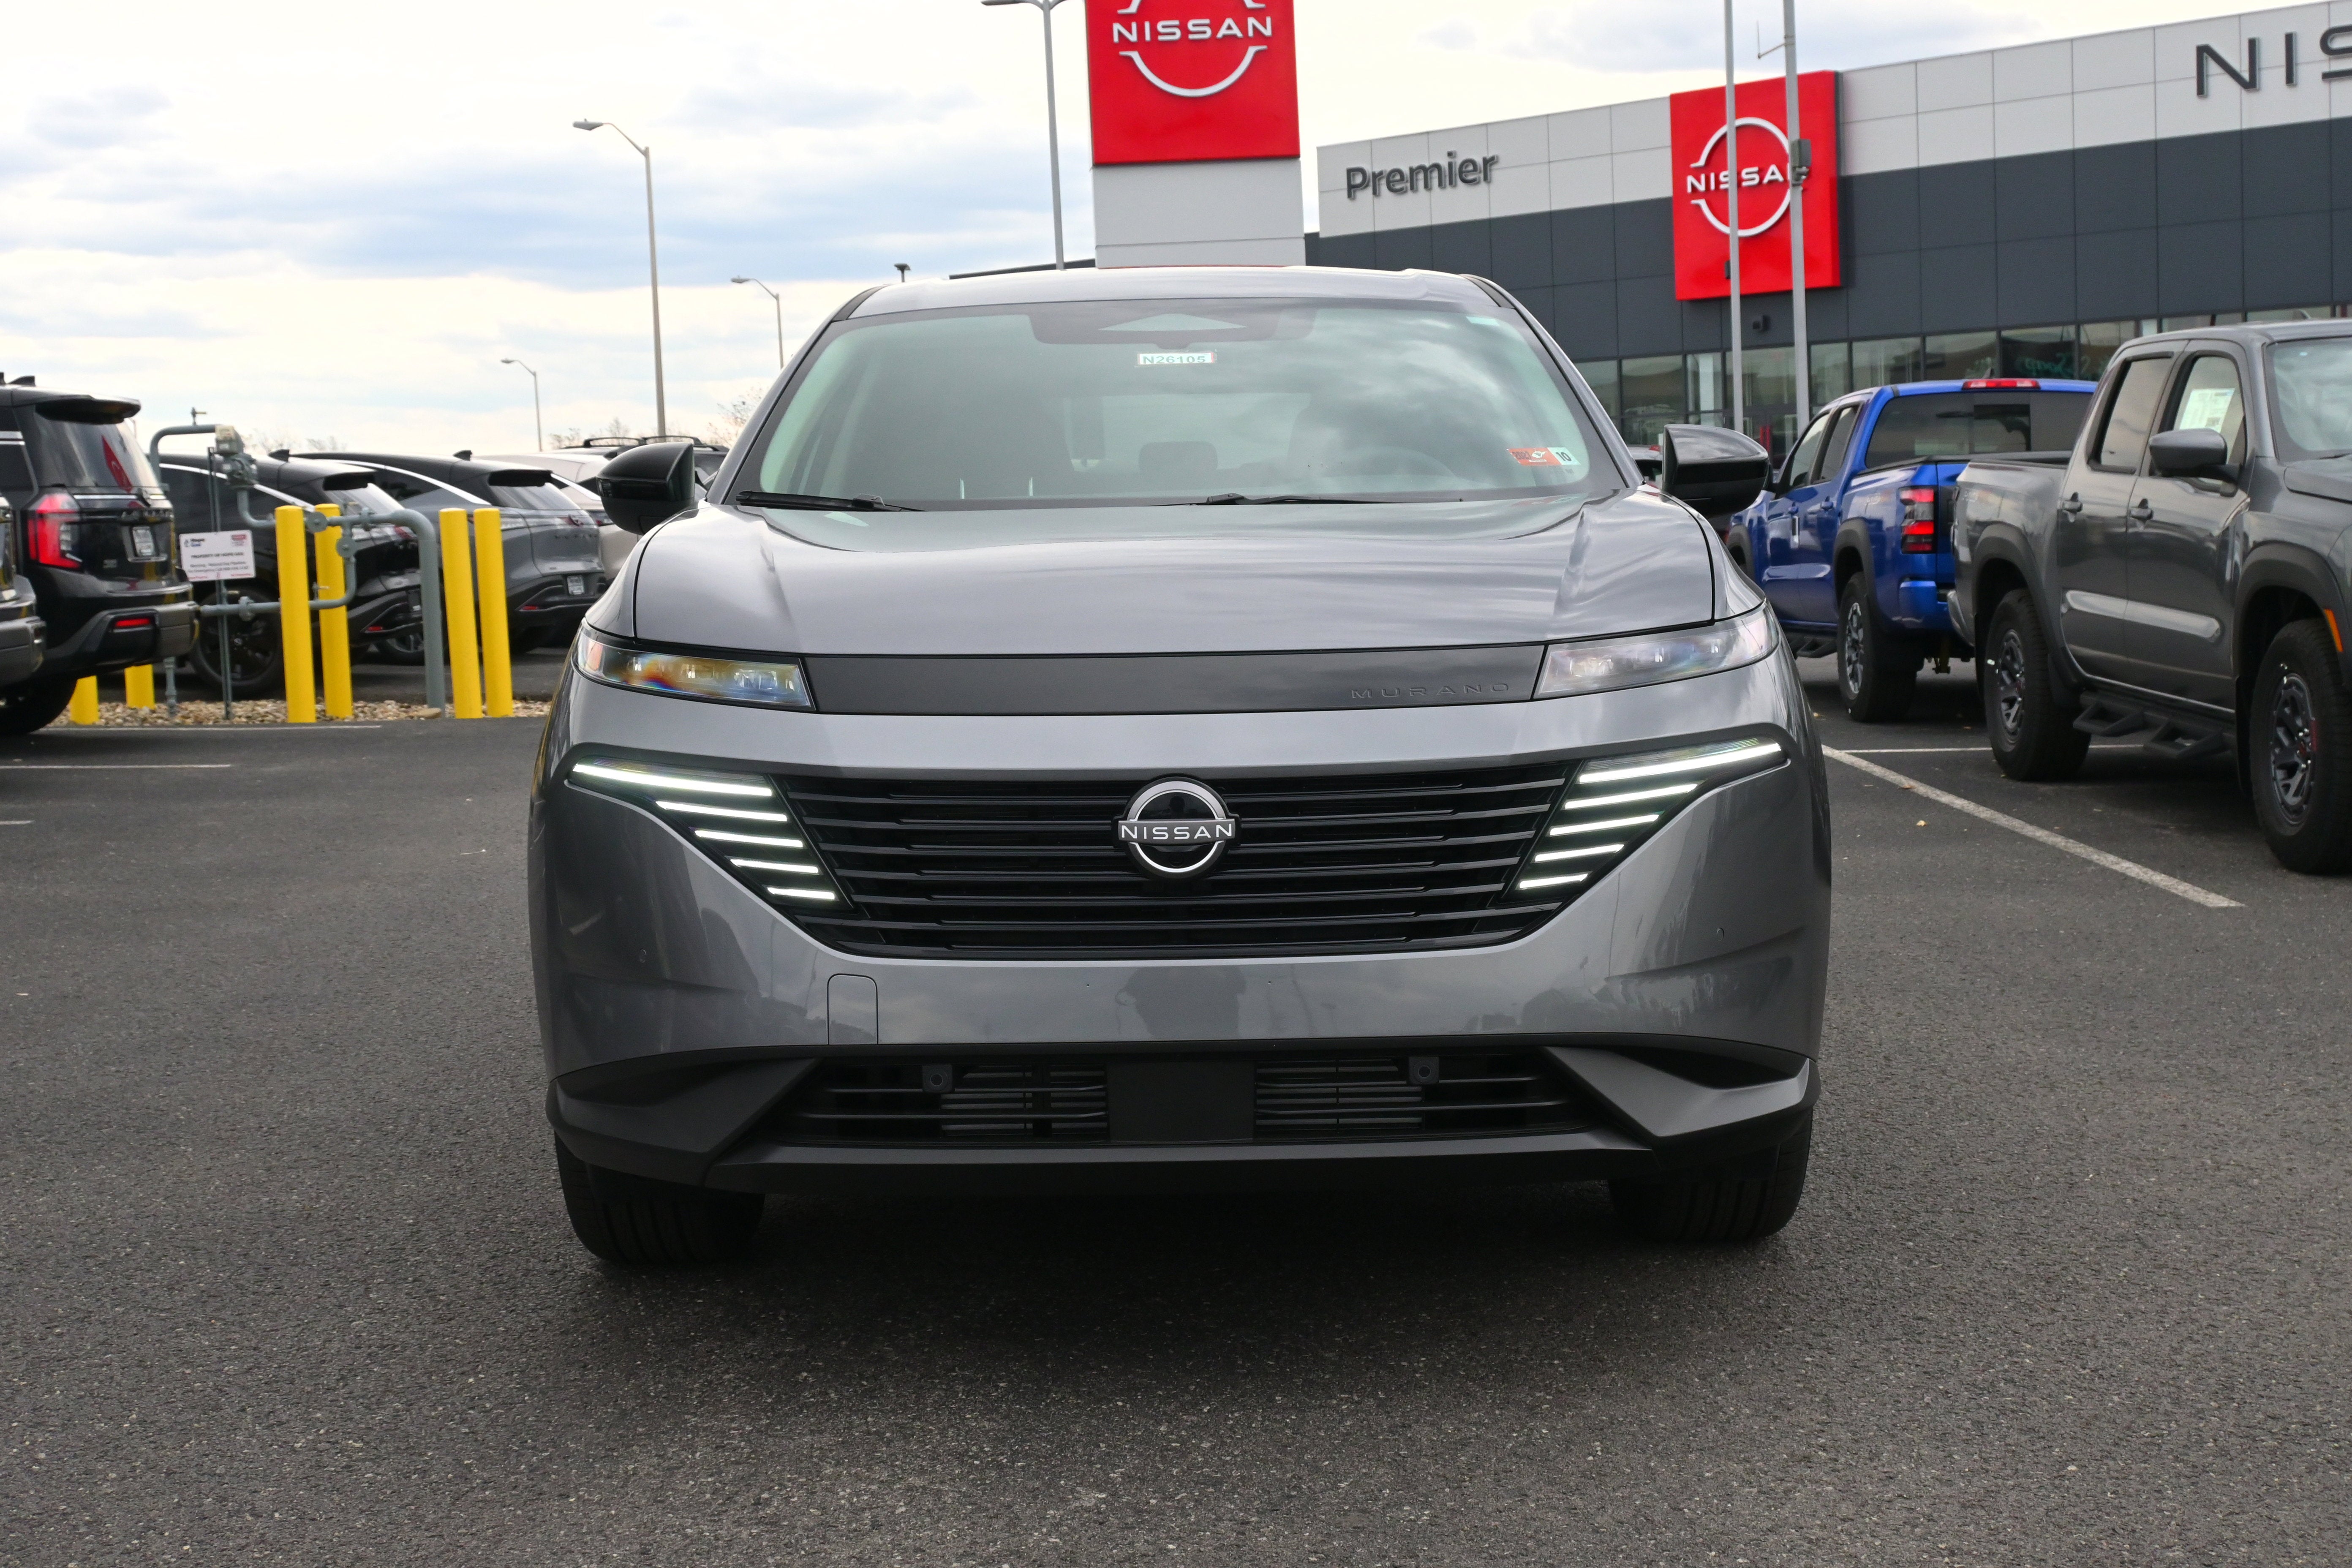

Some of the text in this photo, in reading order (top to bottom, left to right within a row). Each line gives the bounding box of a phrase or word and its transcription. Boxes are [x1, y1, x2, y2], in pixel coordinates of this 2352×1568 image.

[1112, 16, 1272, 43] NISSAN
[1346, 150, 1498, 200] Premier
[1143, 356, 1206, 364] N26105
[1555, 452, 1573, 462] 10
[1352, 683, 1509, 698] MURANO
[1122, 823, 1232, 840] NISSAN
